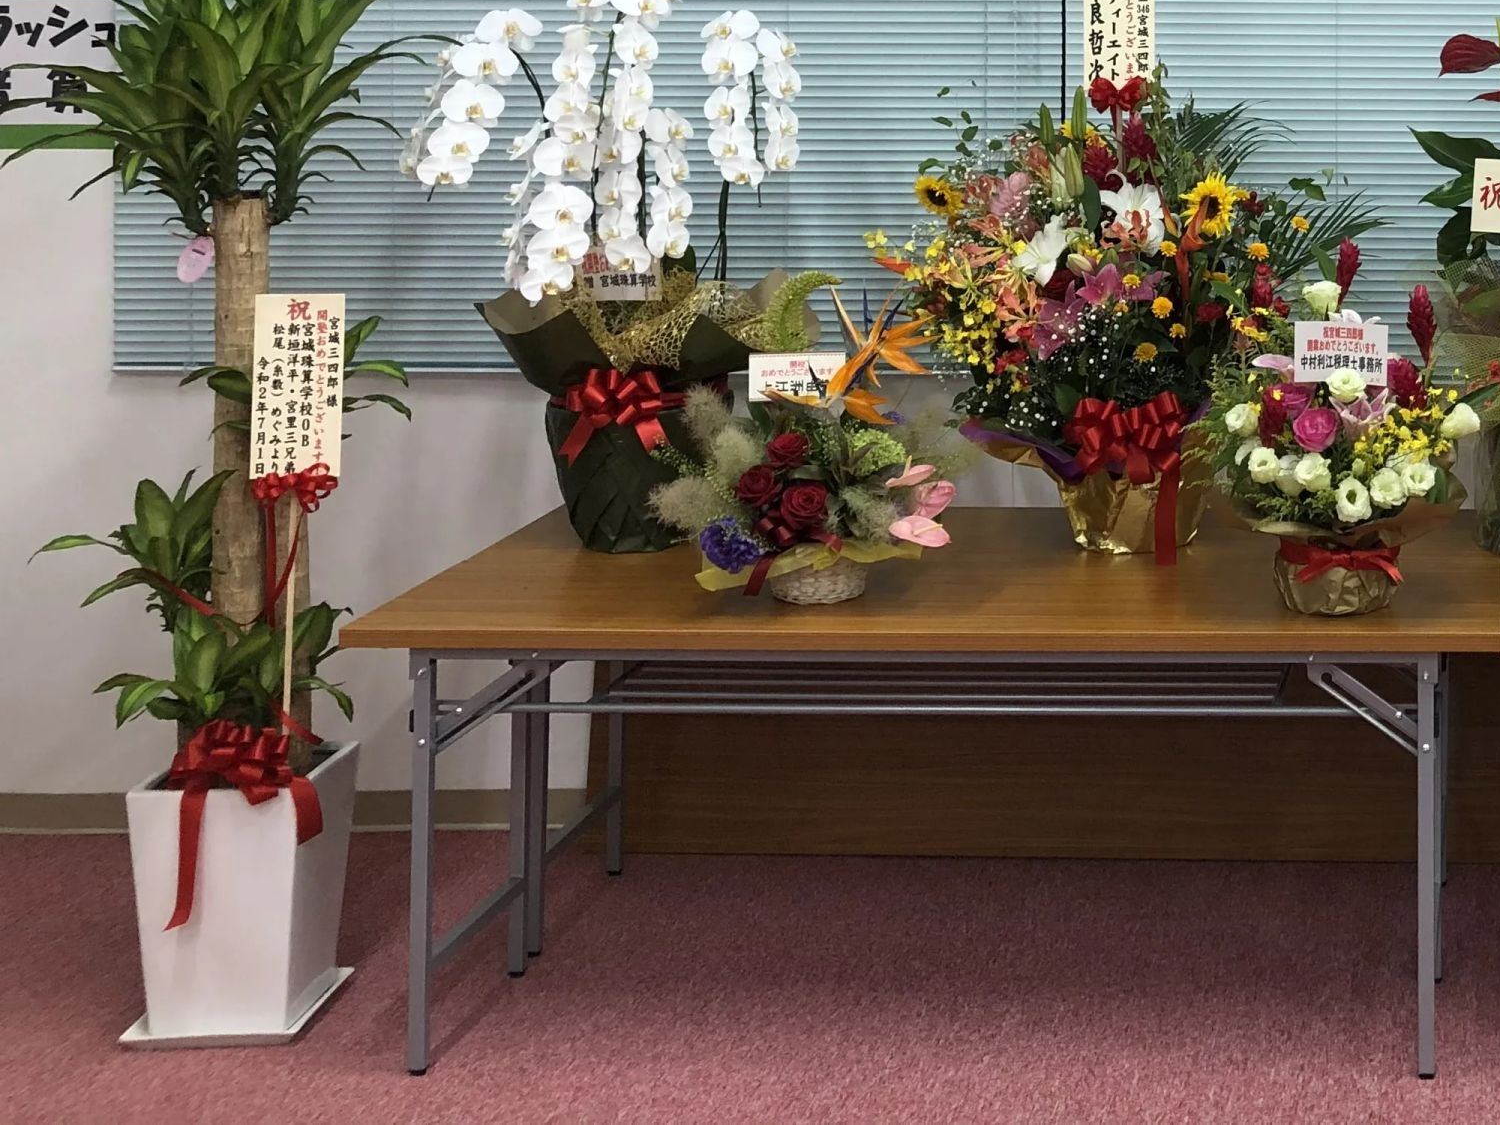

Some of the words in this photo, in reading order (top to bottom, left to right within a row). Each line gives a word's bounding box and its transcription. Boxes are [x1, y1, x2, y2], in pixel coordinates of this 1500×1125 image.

[286, 299, 312, 321] 祝
[1300, 353, 1384, 374] 中村利江税理士事務所
[255, 356, 270, 475] 令和2年7月1日
